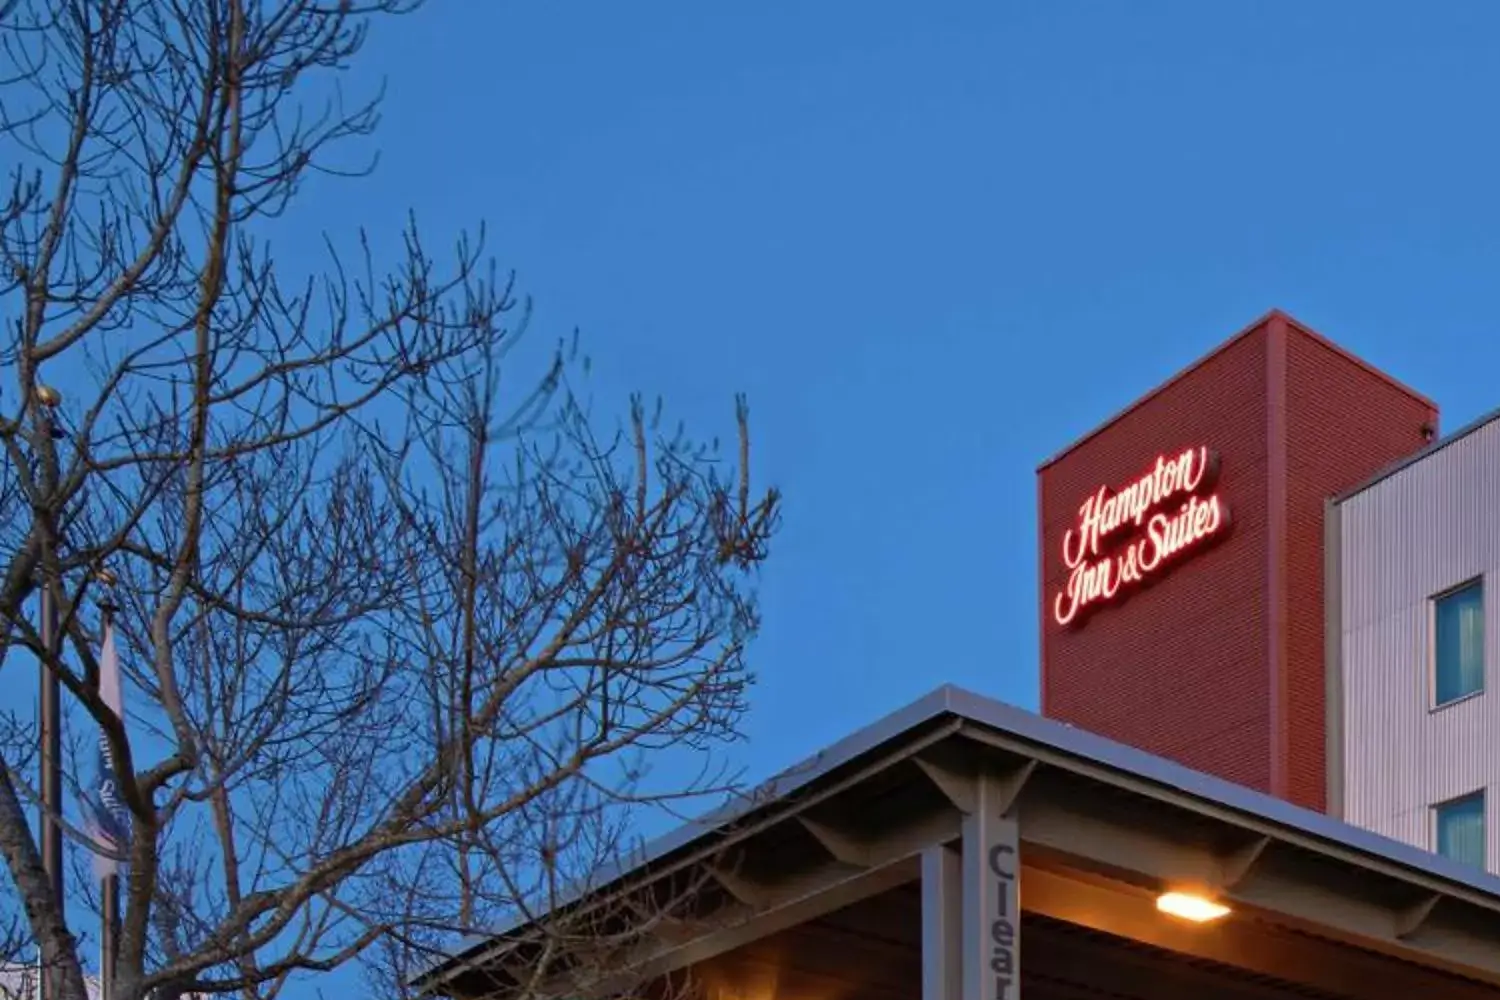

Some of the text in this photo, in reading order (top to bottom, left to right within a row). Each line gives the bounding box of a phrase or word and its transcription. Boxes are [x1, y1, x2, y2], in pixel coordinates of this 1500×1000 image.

[1055, 495, 1220, 625] Inn & Suites
[1063, 446, 1206, 568] Hampton
